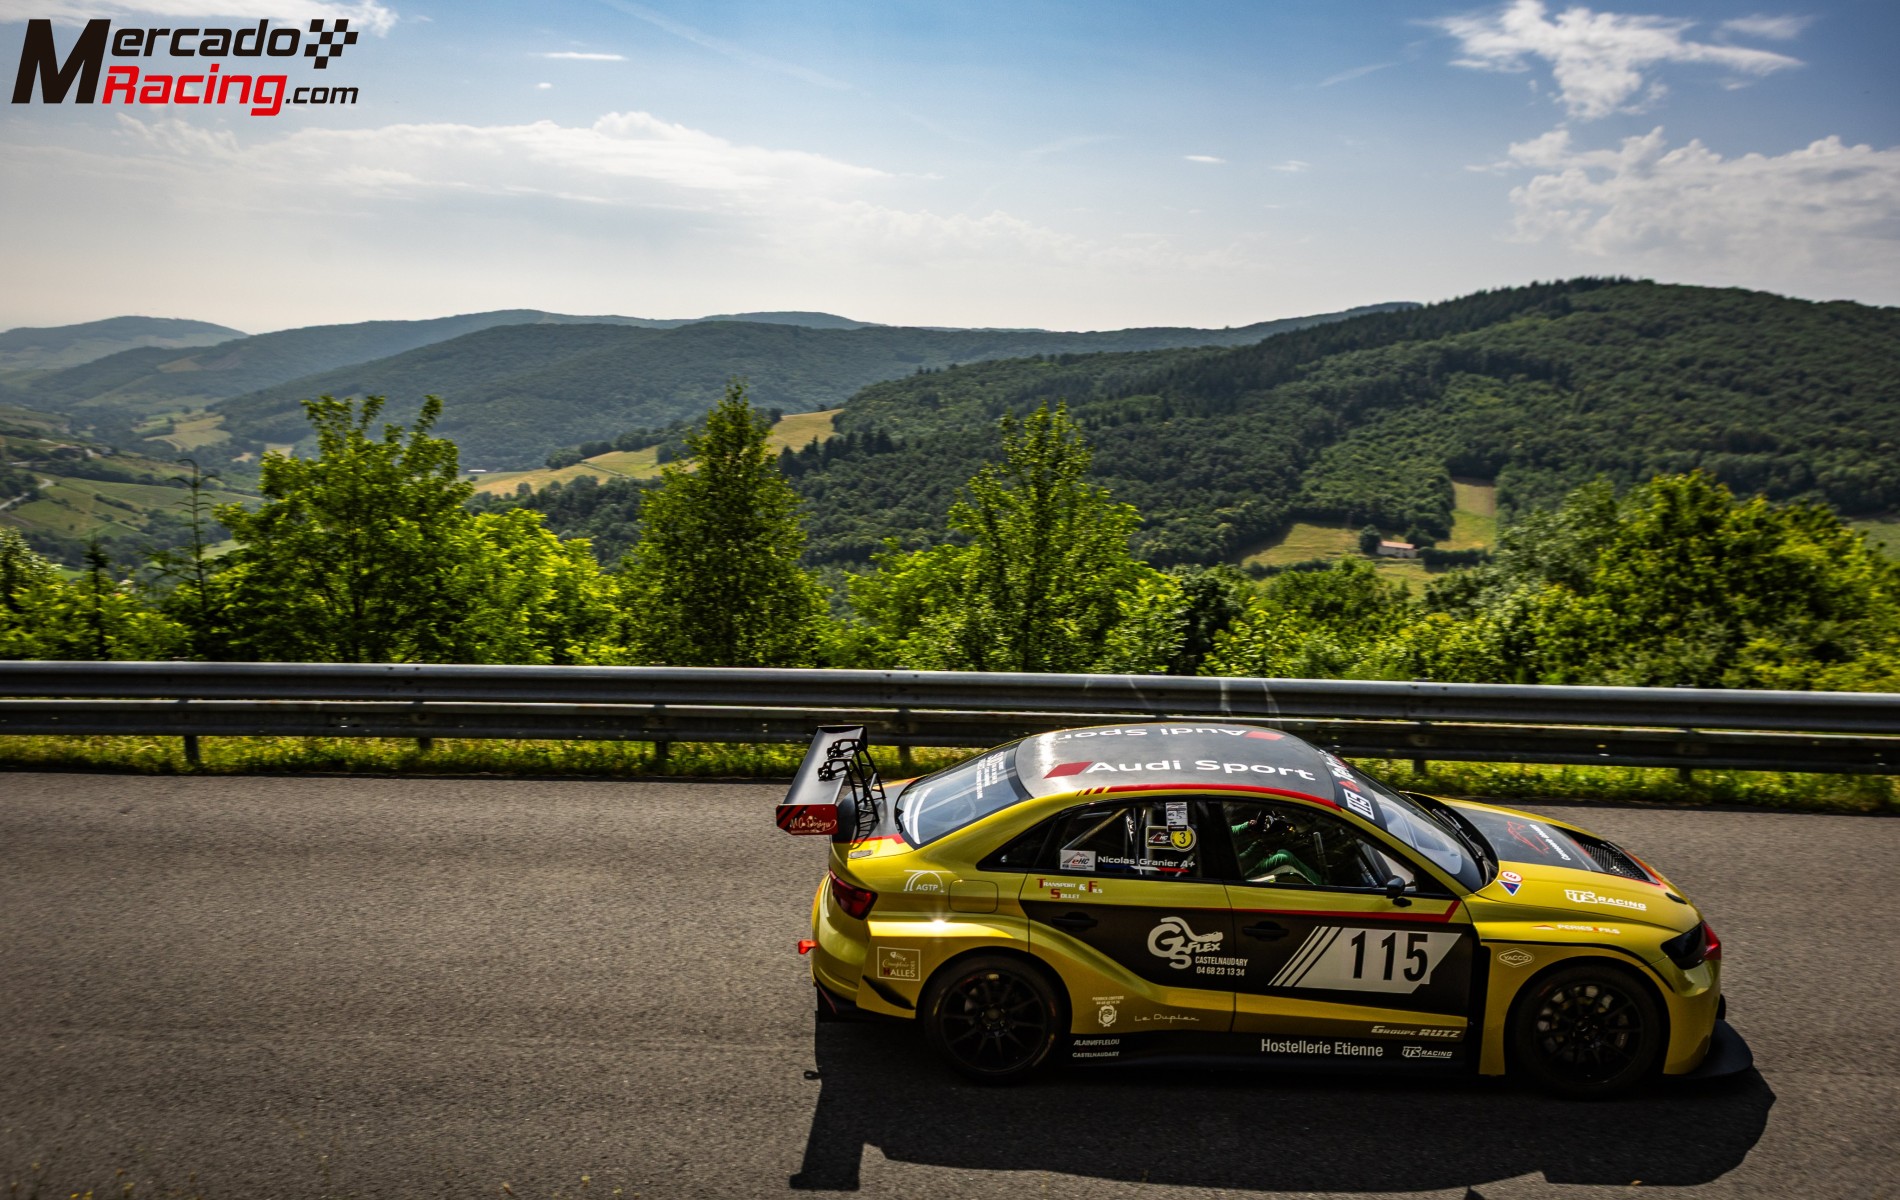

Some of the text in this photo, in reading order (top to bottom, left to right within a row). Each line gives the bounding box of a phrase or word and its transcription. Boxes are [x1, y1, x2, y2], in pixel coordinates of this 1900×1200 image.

[1160, 728, 1247, 736] Audi
[1086, 760, 1182, 774] Audi
[1194, 760, 1316, 781] Sport
[1179, 832, 1187, 845] 3
[1097, 856, 1196, 868] Nicolas Granier A+
[916, 884, 938, 892] AGTP
[1078, 883, 1086, 891] &
[1598, 896, 1648, 910] RACING
[1195, 956, 1248, 967] CASTELNAUDARY
[1351, 930, 1429, 982] 115
[1196, 966, 1206, 974] 04
[1216, 967, 1225, 975] 23
[1227, 968, 1235, 976] 13
[1236, 968, 1245, 976] 34
[1153, 1013, 1200, 1023] Duplex
[1261, 1038, 1384, 1056] Hostellerie Etienne
[1421, 1049, 1453, 1058] RACING
